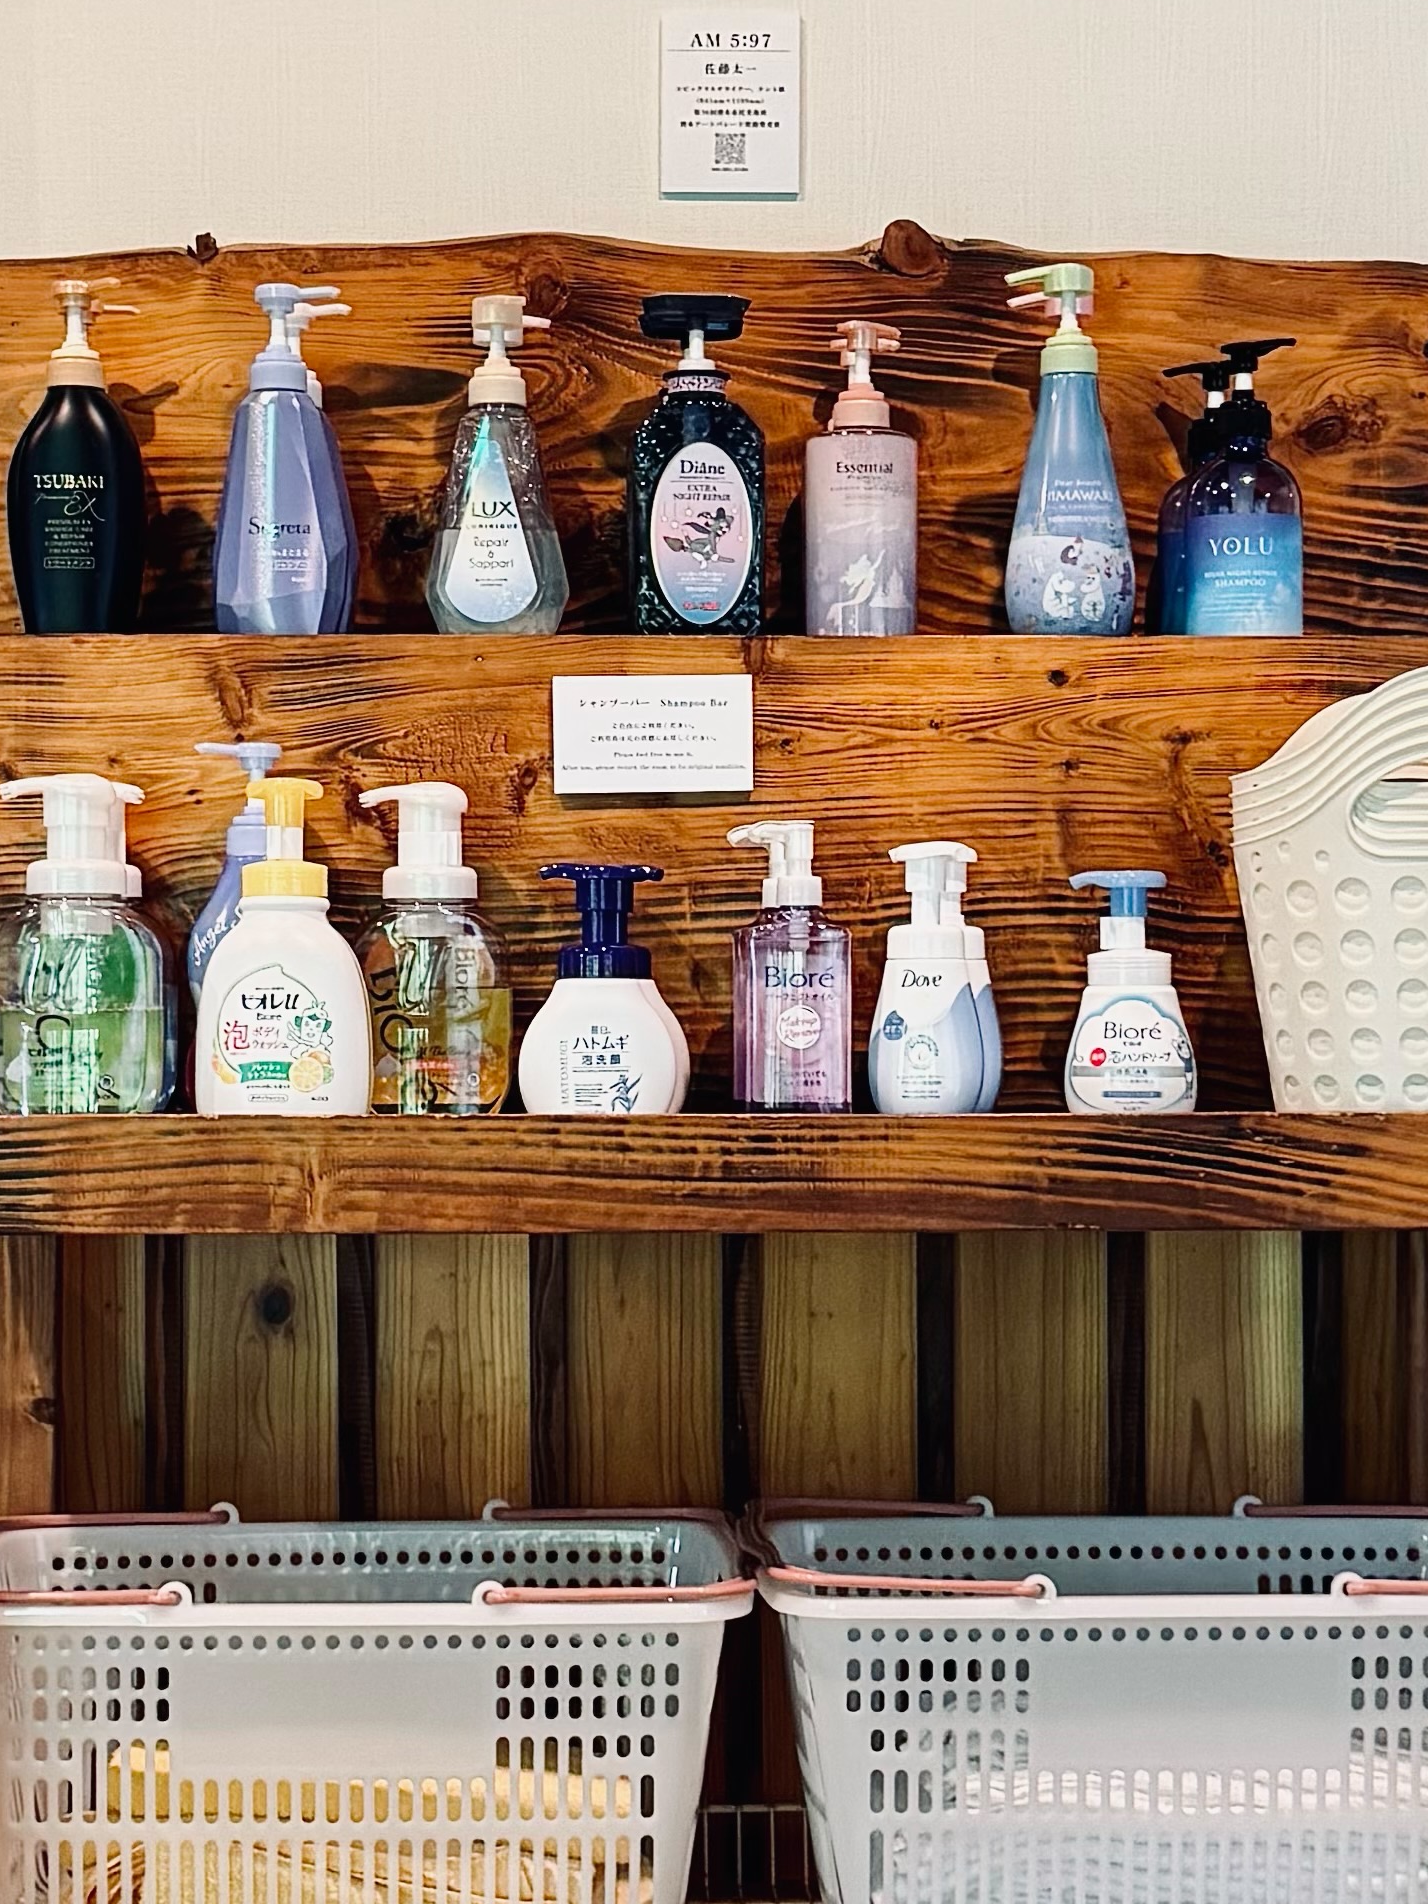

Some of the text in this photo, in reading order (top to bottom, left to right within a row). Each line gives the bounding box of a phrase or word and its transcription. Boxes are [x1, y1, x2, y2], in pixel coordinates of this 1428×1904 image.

[690, 33, 772, 48] AM 5:97
[836, 461, 893, 474] Essential
[33, 474, 104, 489] TSUBAKI
[472, 501, 516, 518] LUX
[474, 536, 509, 548] Repair
[1209, 536, 1273, 556] YOLU
[660, 698, 706, 709] Shampoo
[710, 698, 728, 707] Bar
[765, 965, 835, 988] Bioré
[901, 969, 943, 987] Dove
[223, 1020, 251, 1051] 泡
[1103, 1021, 1163, 1040] Bioré
[573, 1034, 630, 1050] ハトムギ
